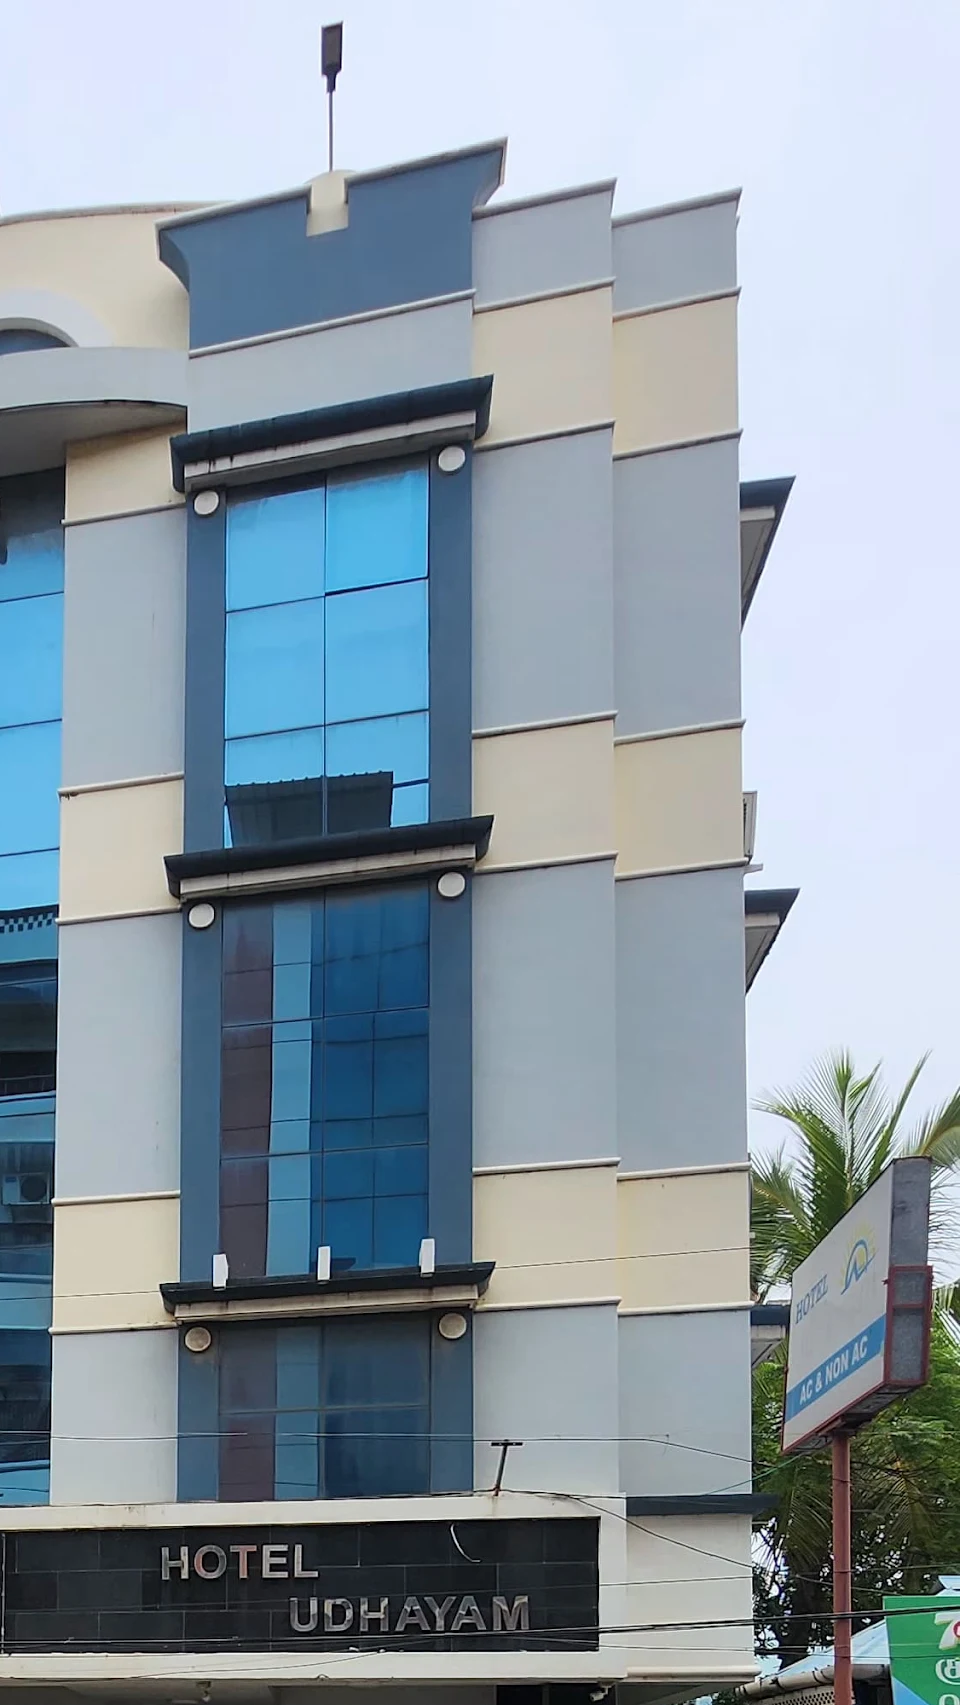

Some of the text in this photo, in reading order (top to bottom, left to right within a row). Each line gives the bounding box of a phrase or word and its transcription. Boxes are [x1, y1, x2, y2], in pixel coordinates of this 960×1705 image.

[795, 1274, 829, 1324] HOTEL
[799, 1335, 869, 1405] AC & NON AC
[161, 1544, 319, 1580] HOTEL
[289, 1595, 530, 1633] UDHAYAM
